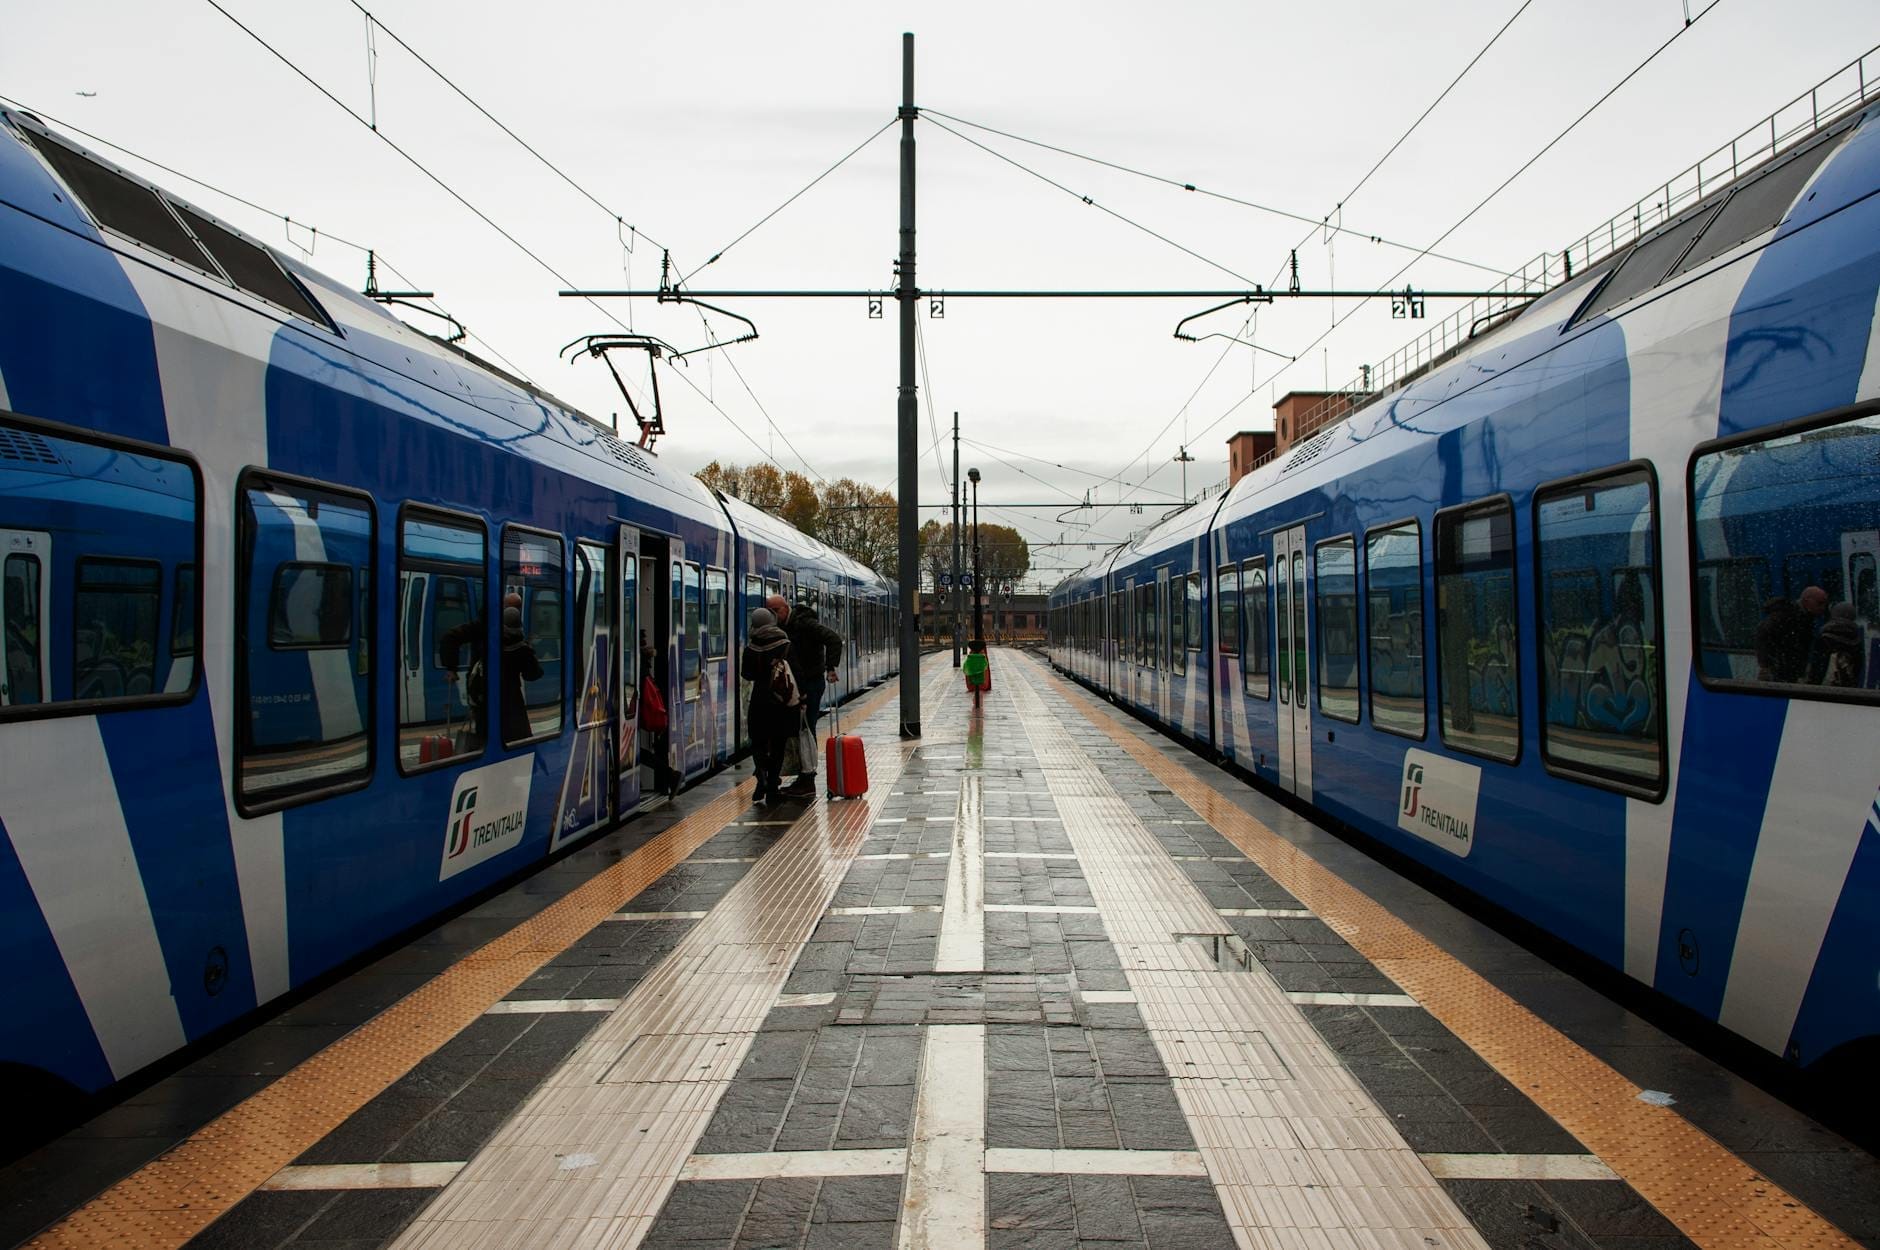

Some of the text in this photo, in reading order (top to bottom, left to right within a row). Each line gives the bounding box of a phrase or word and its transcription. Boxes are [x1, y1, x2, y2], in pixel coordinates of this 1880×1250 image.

[869, 301, 882, 318] 2
[931, 301, 943, 318] 2
[473, 811, 523, 848] TRENITALIA
[1421, 805, 1469, 842] TRENITALIA
